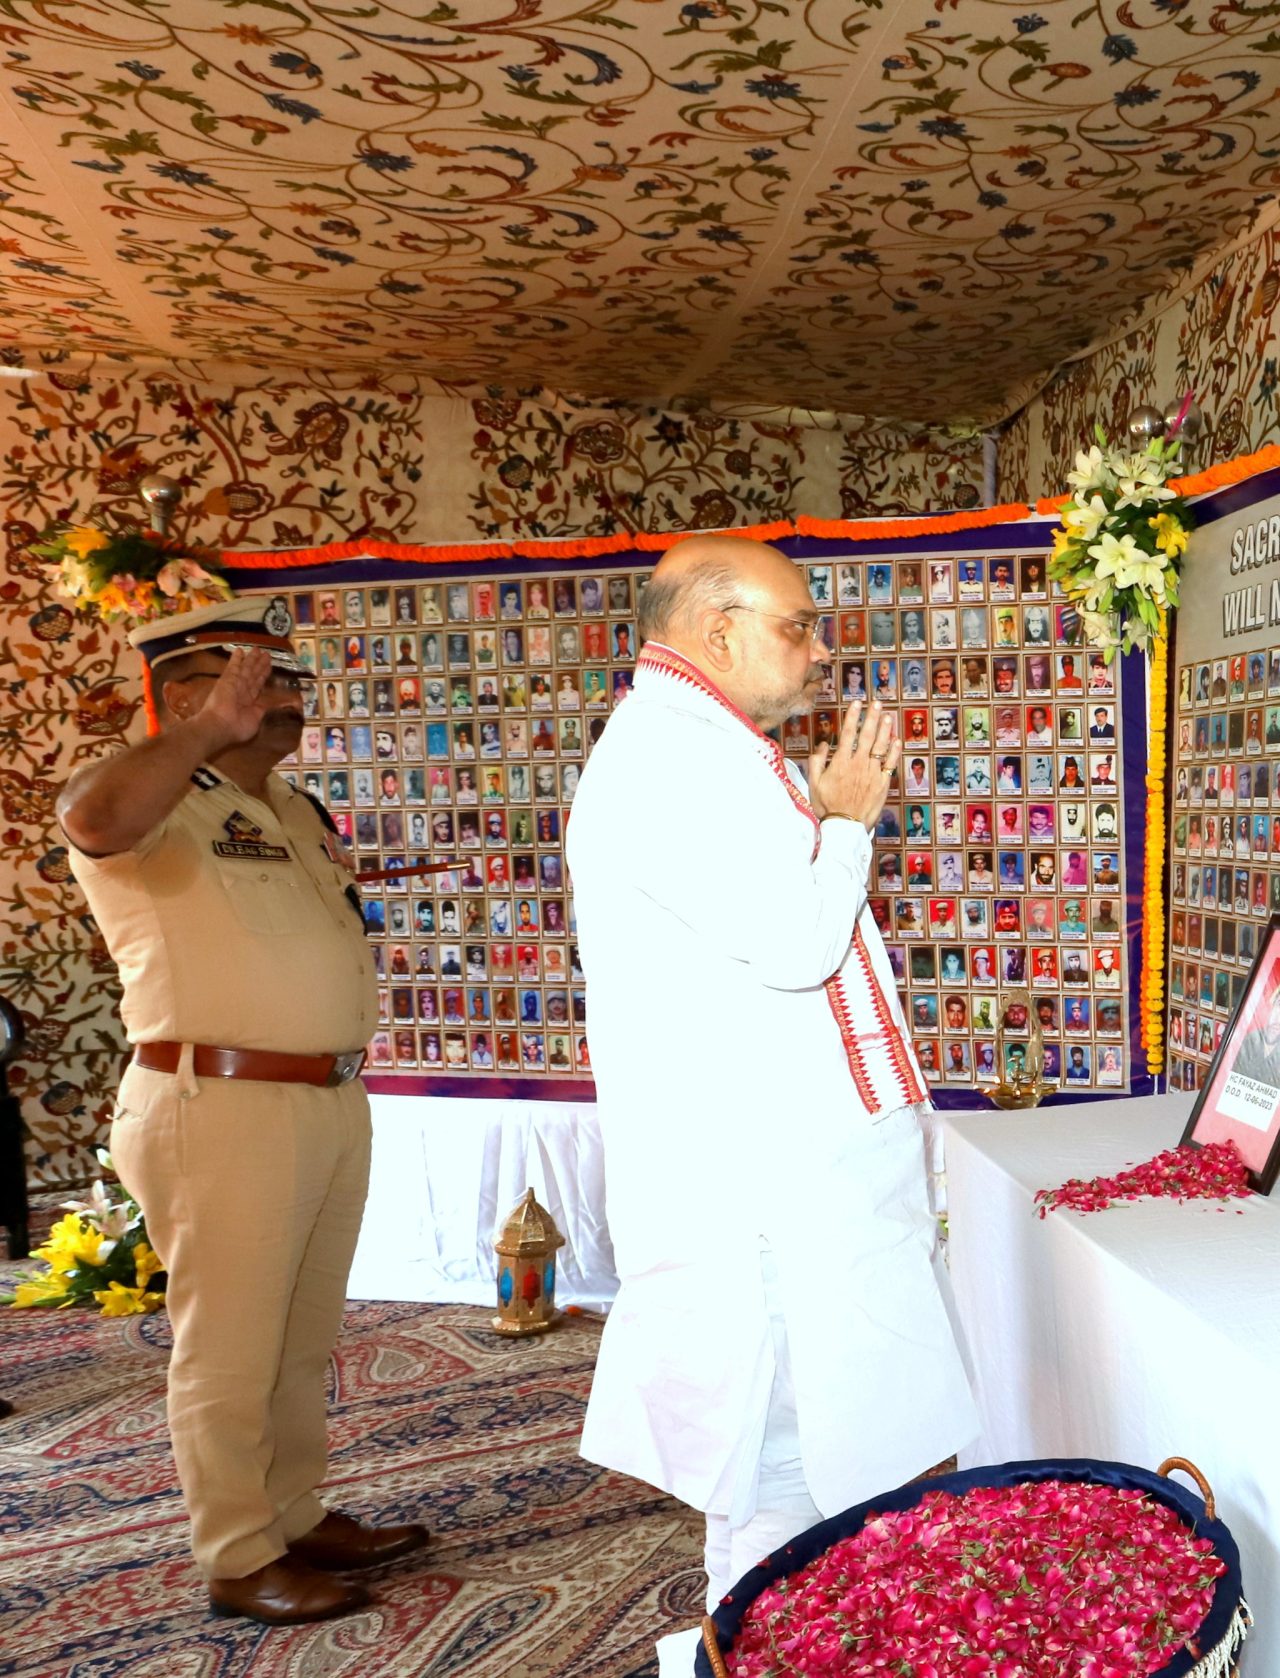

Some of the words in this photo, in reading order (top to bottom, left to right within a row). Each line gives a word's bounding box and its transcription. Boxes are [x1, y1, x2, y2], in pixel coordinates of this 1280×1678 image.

[1223, 583, 1265, 638] WILL
[1229, 1074, 1239, 1084] HC
[1239, 1077, 1257, 1091] FAYAZ
[1256, 1084, 1278, 1099] AHMAD
